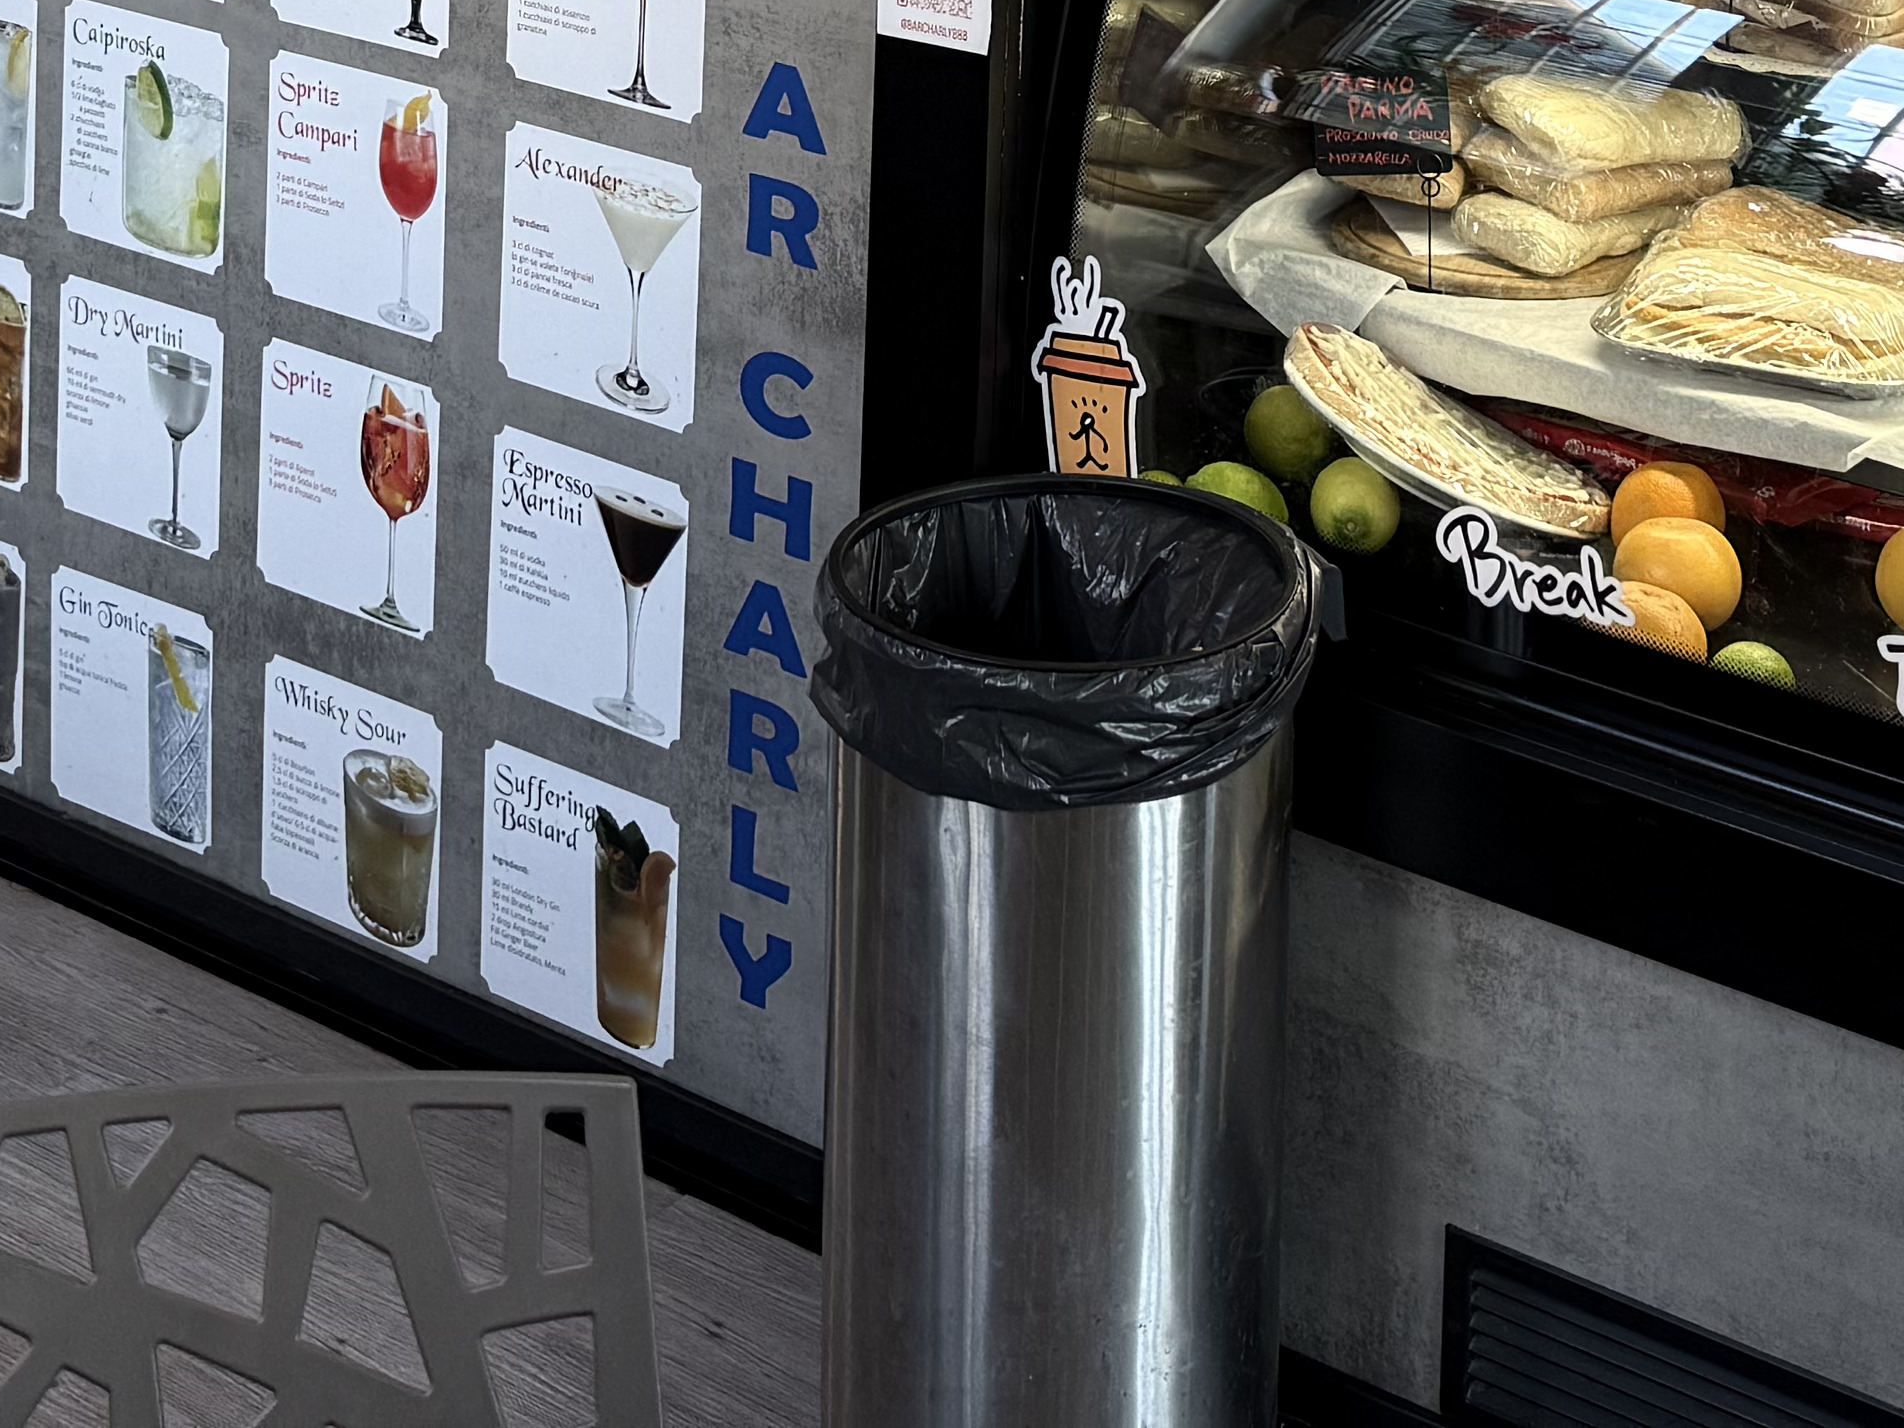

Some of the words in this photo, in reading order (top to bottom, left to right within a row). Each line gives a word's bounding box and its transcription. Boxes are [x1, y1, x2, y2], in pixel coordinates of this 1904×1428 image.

[72, 18, 165, 62] Caipiroska
[278, 72, 339, 110] Spritz
[1348, 96, 1433, 122] PARMA
[277, 112, 358, 152] Campari
[515, 147, 624, 193] Alexander
[741, 61, 827, 271] AR
[68, 296, 107, 337] Dry
[114, 311, 183, 349] Martini
[271, 359, 333, 400] Spritz
[503, 448, 593, 499] Espresso
[501, 478, 585, 527] Martini
[1444, 512, 1630, 622] Break
[59, 586, 93, 617] Gin
[97, 598, 149, 635] Tonic
[720, 351, 813, 1009] CHARLY
[275, 676, 349, 733] Whisky
[355, 708, 407, 746] Sour
[494, 762, 596, 833] Suffering
[494, 798, 578, 851] Bastard
